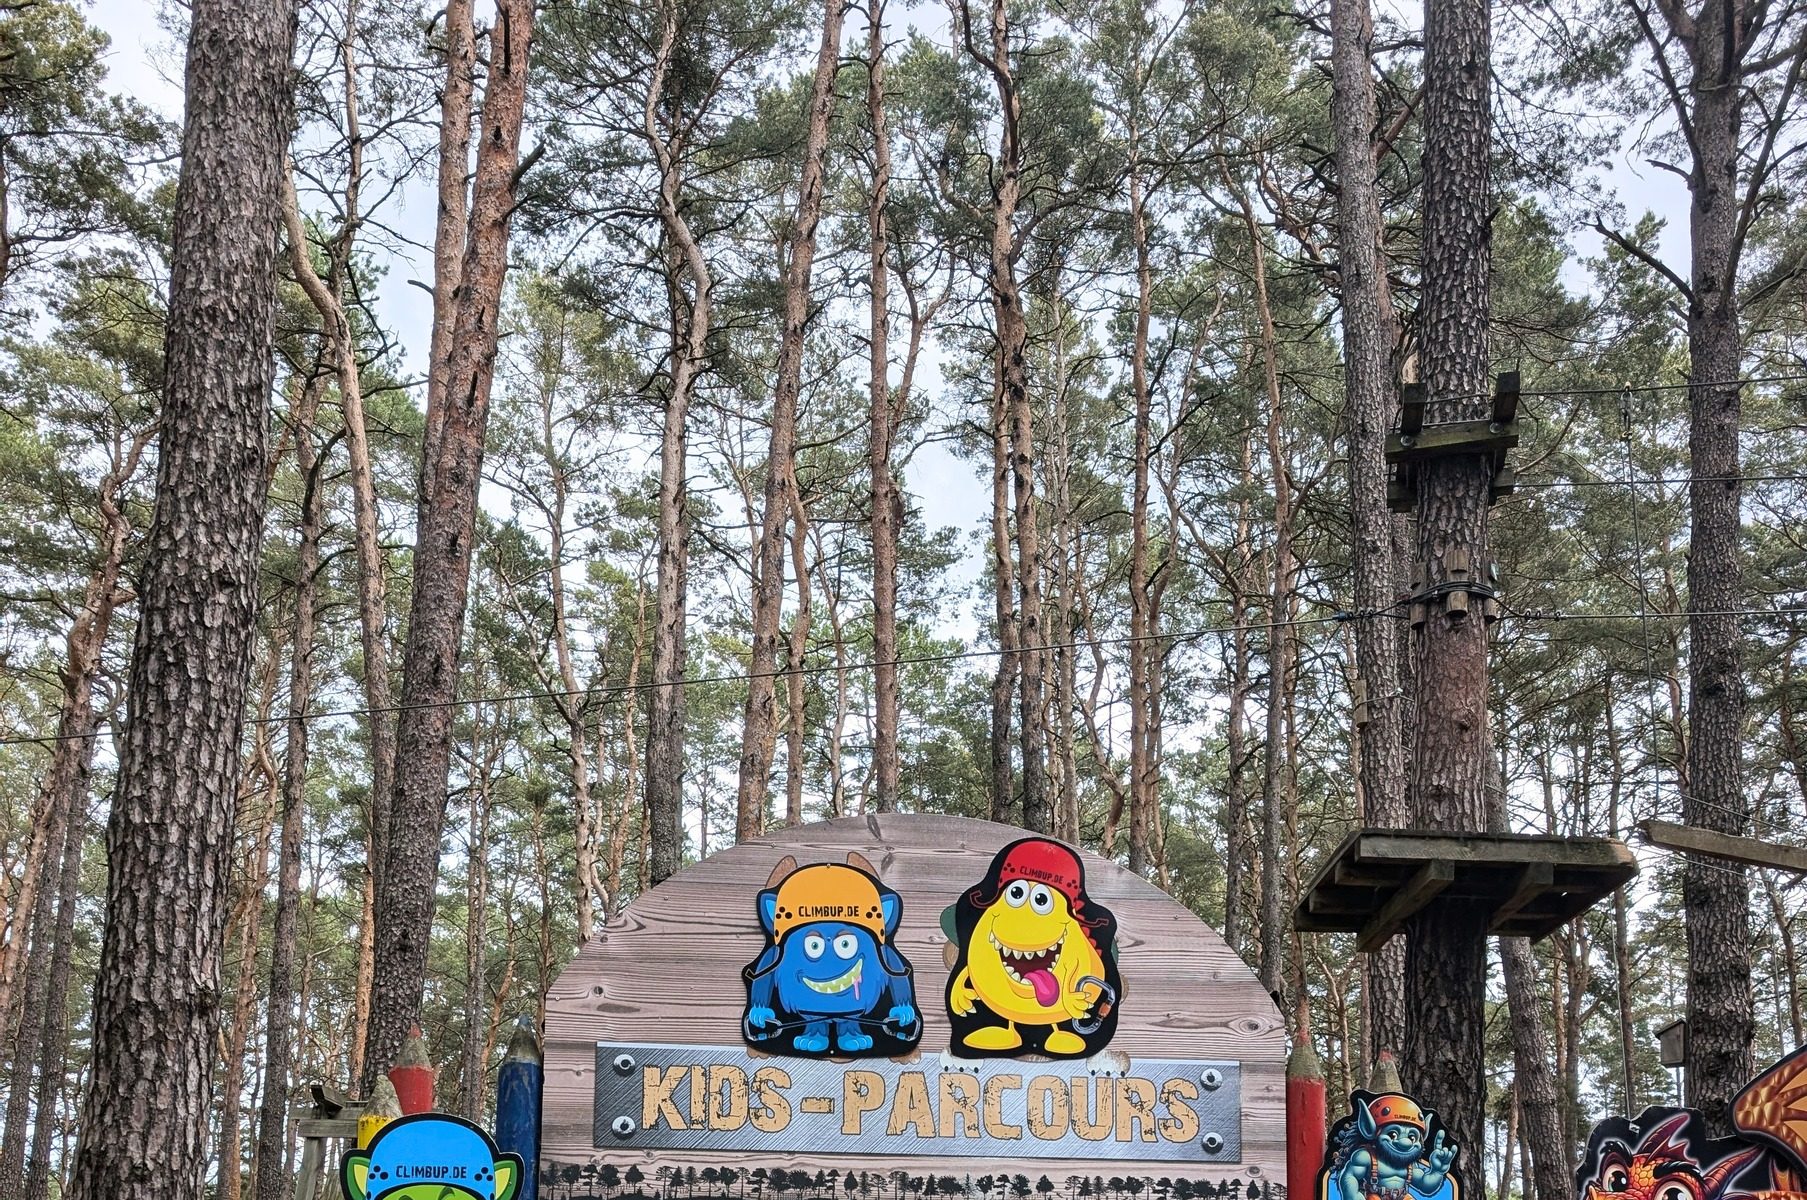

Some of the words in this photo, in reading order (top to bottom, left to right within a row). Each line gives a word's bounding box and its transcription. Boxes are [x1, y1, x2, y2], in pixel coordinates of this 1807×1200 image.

[1019, 865, 1064, 885] CLIMBUP.DE
[798, 905, 860, 918] CLIMBUP.DE
[641, 1064, 1201, 1145] KIDS-PARCOURS
[395, 1165, 467, 1179] CLIMBUP.DE
